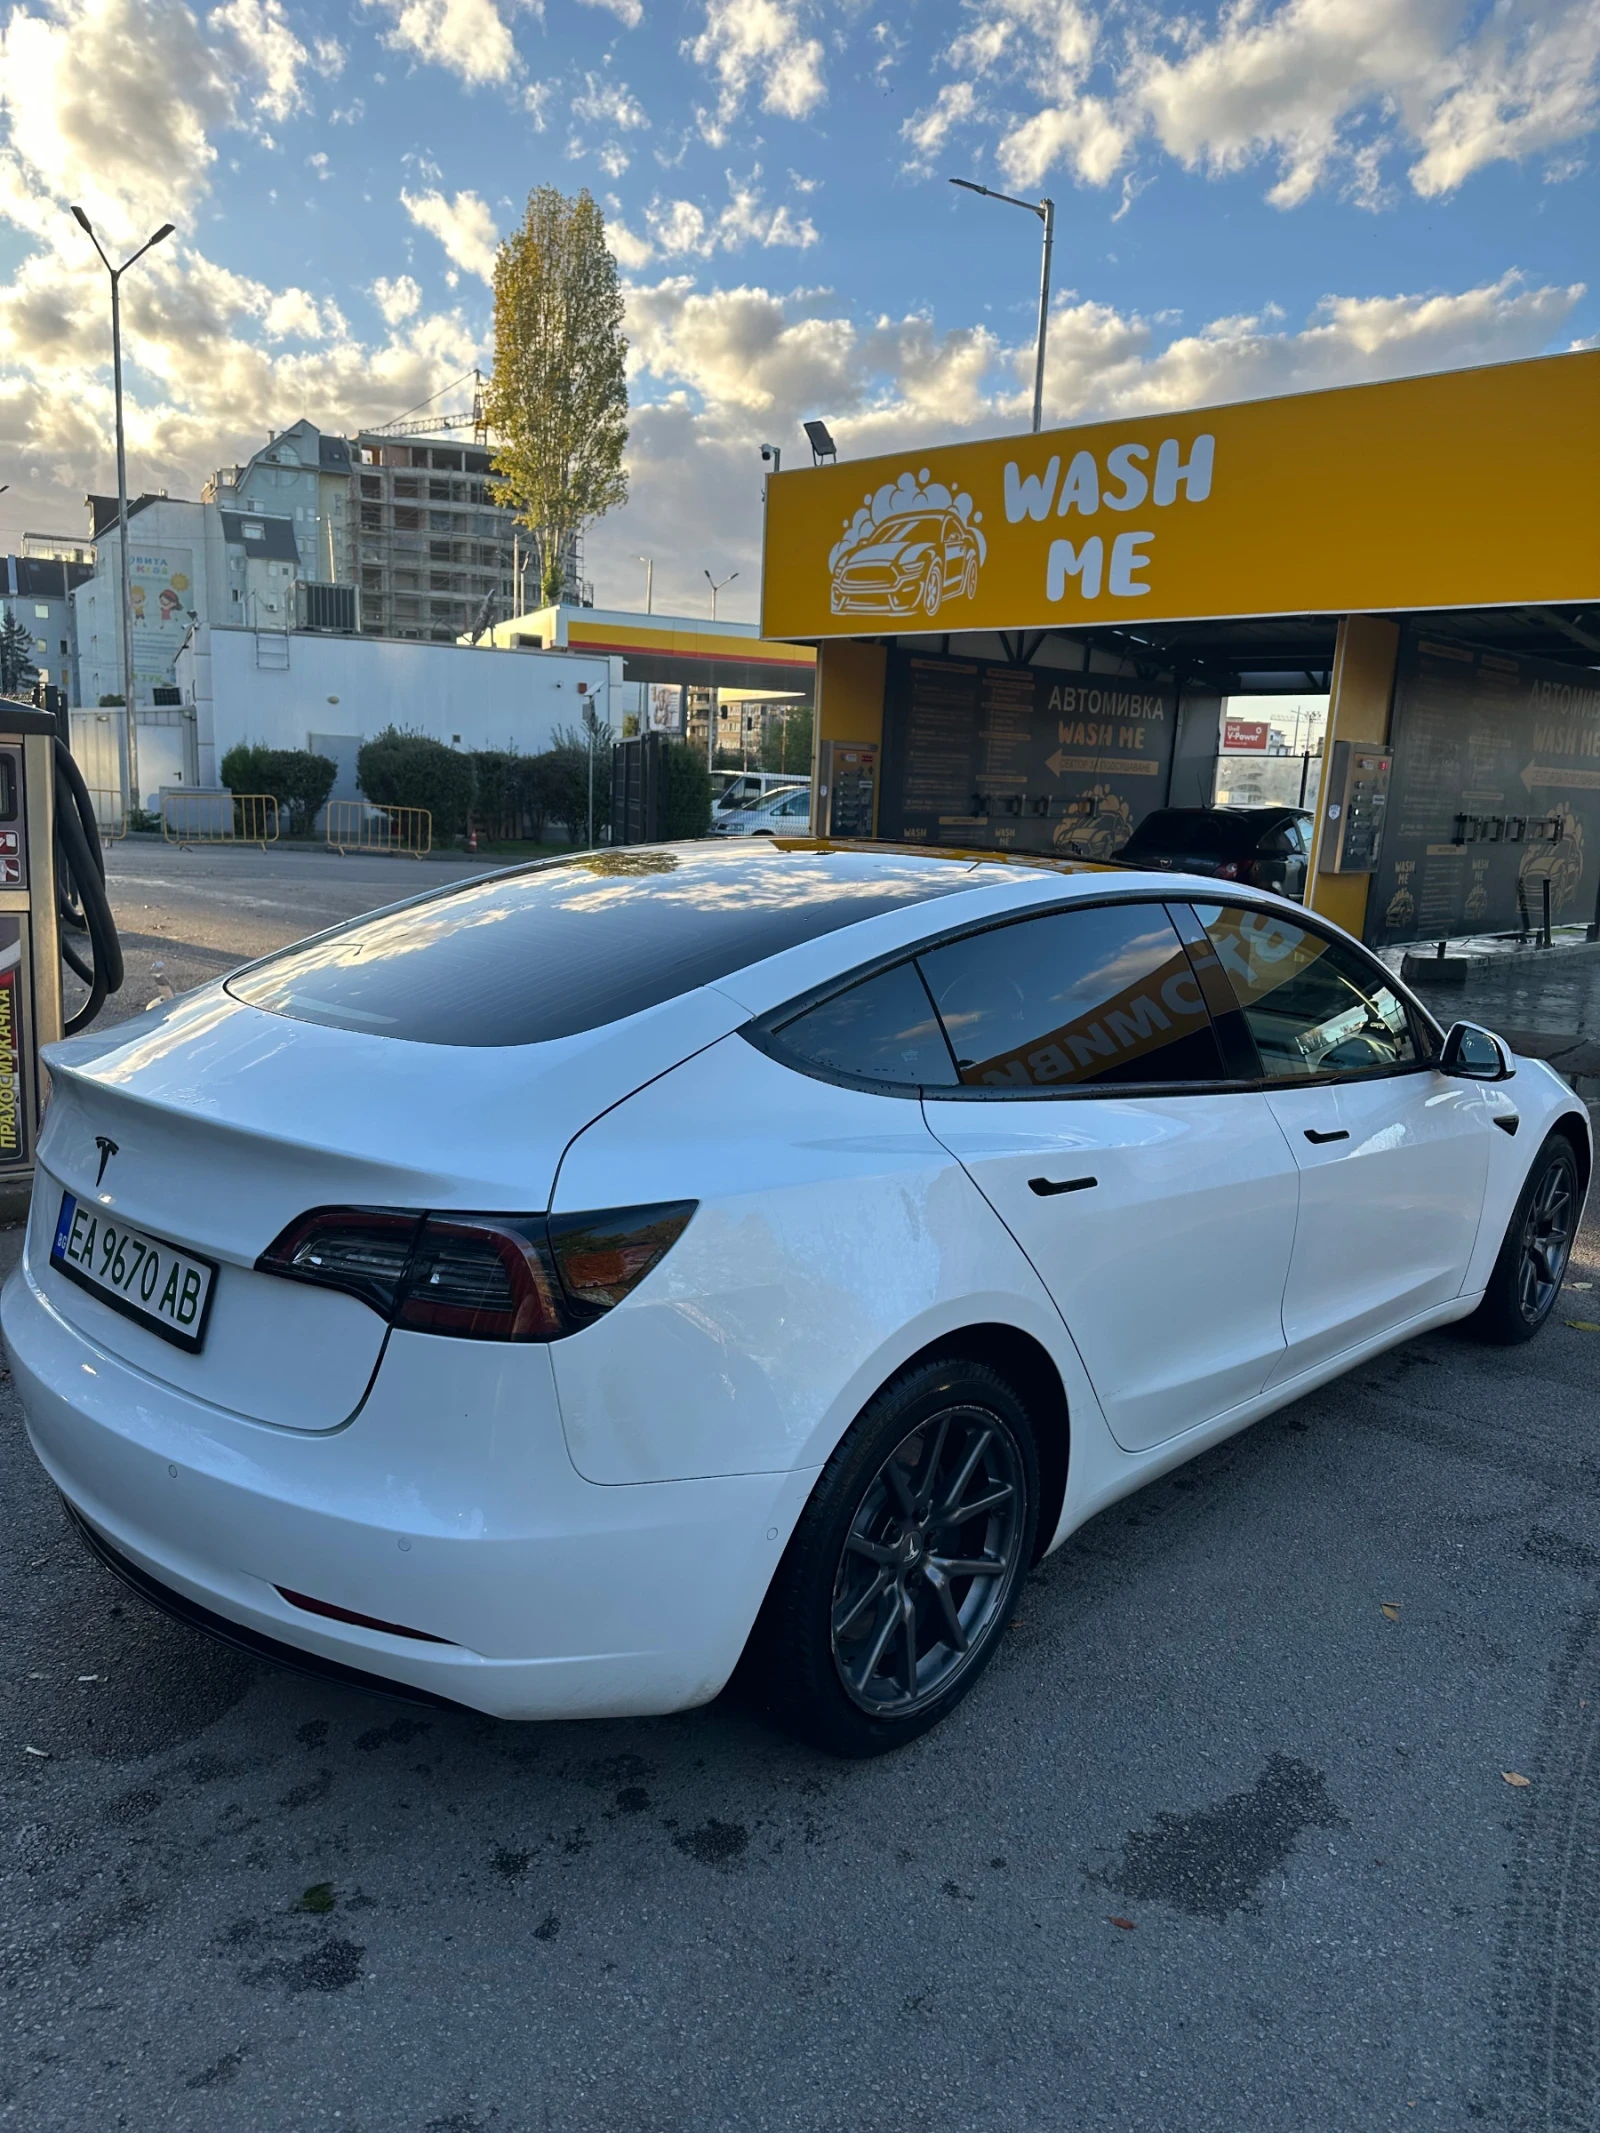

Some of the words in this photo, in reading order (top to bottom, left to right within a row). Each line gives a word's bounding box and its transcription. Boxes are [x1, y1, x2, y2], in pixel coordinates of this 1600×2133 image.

[1004, 434, 1215, 523] WASH
[1046, 531, 1155, 602] ME
[1048, 686, 1164, 720] АВТОМИВКА
[1058, 721, 1113, 746] WASH
[1118, 726, 1146, 749] ME
[1227, 731, 1259, 741] V-Power
[1533, 723, 1577, 755] WASH
[904, 828, 927, 838] WASH
[995, 828, 1015, 837] WASH
[1395, 860, 1416, 873] WASH
[1398, 873, 1410, 885] ME
[0, 989, 17, 1149] ПРАХОСМУКАЧКА
[57, 1232, 68, 1250] BG
[67, 1208, 98, 1270] EA
[100, 1227, 159, 1301] 9670
[158, 1261, 201, 1325] AB
